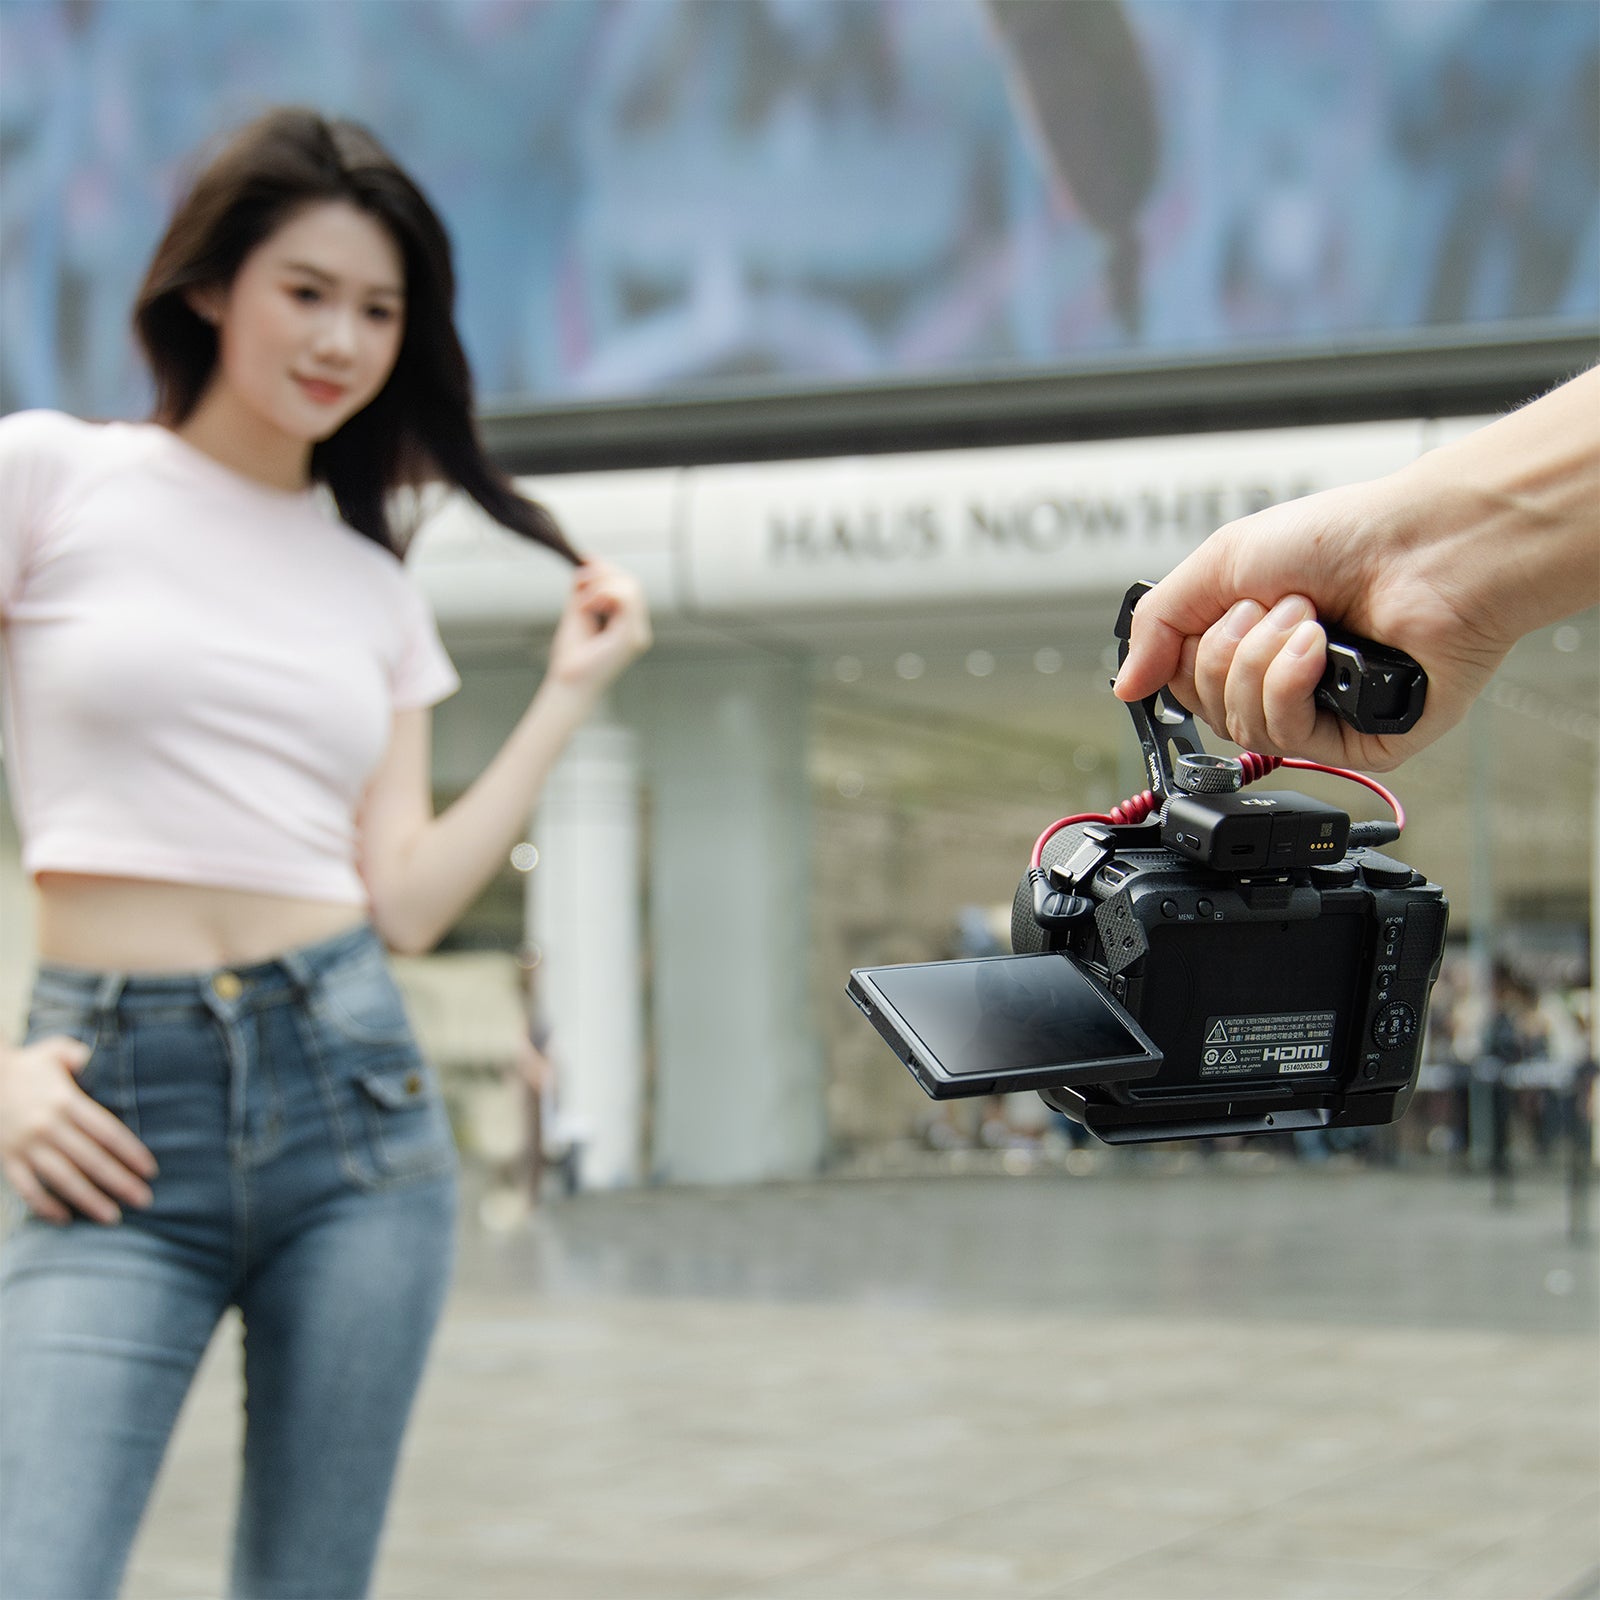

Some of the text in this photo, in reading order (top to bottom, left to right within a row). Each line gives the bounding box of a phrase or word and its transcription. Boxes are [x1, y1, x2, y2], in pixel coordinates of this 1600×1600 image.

[767, 500, 940, 563] HAUS
[1390, 930, 1396, 938] 2
[1383, 977, 1389, 986] 3
[1262, 1044, 1324, 1061] HDMI
